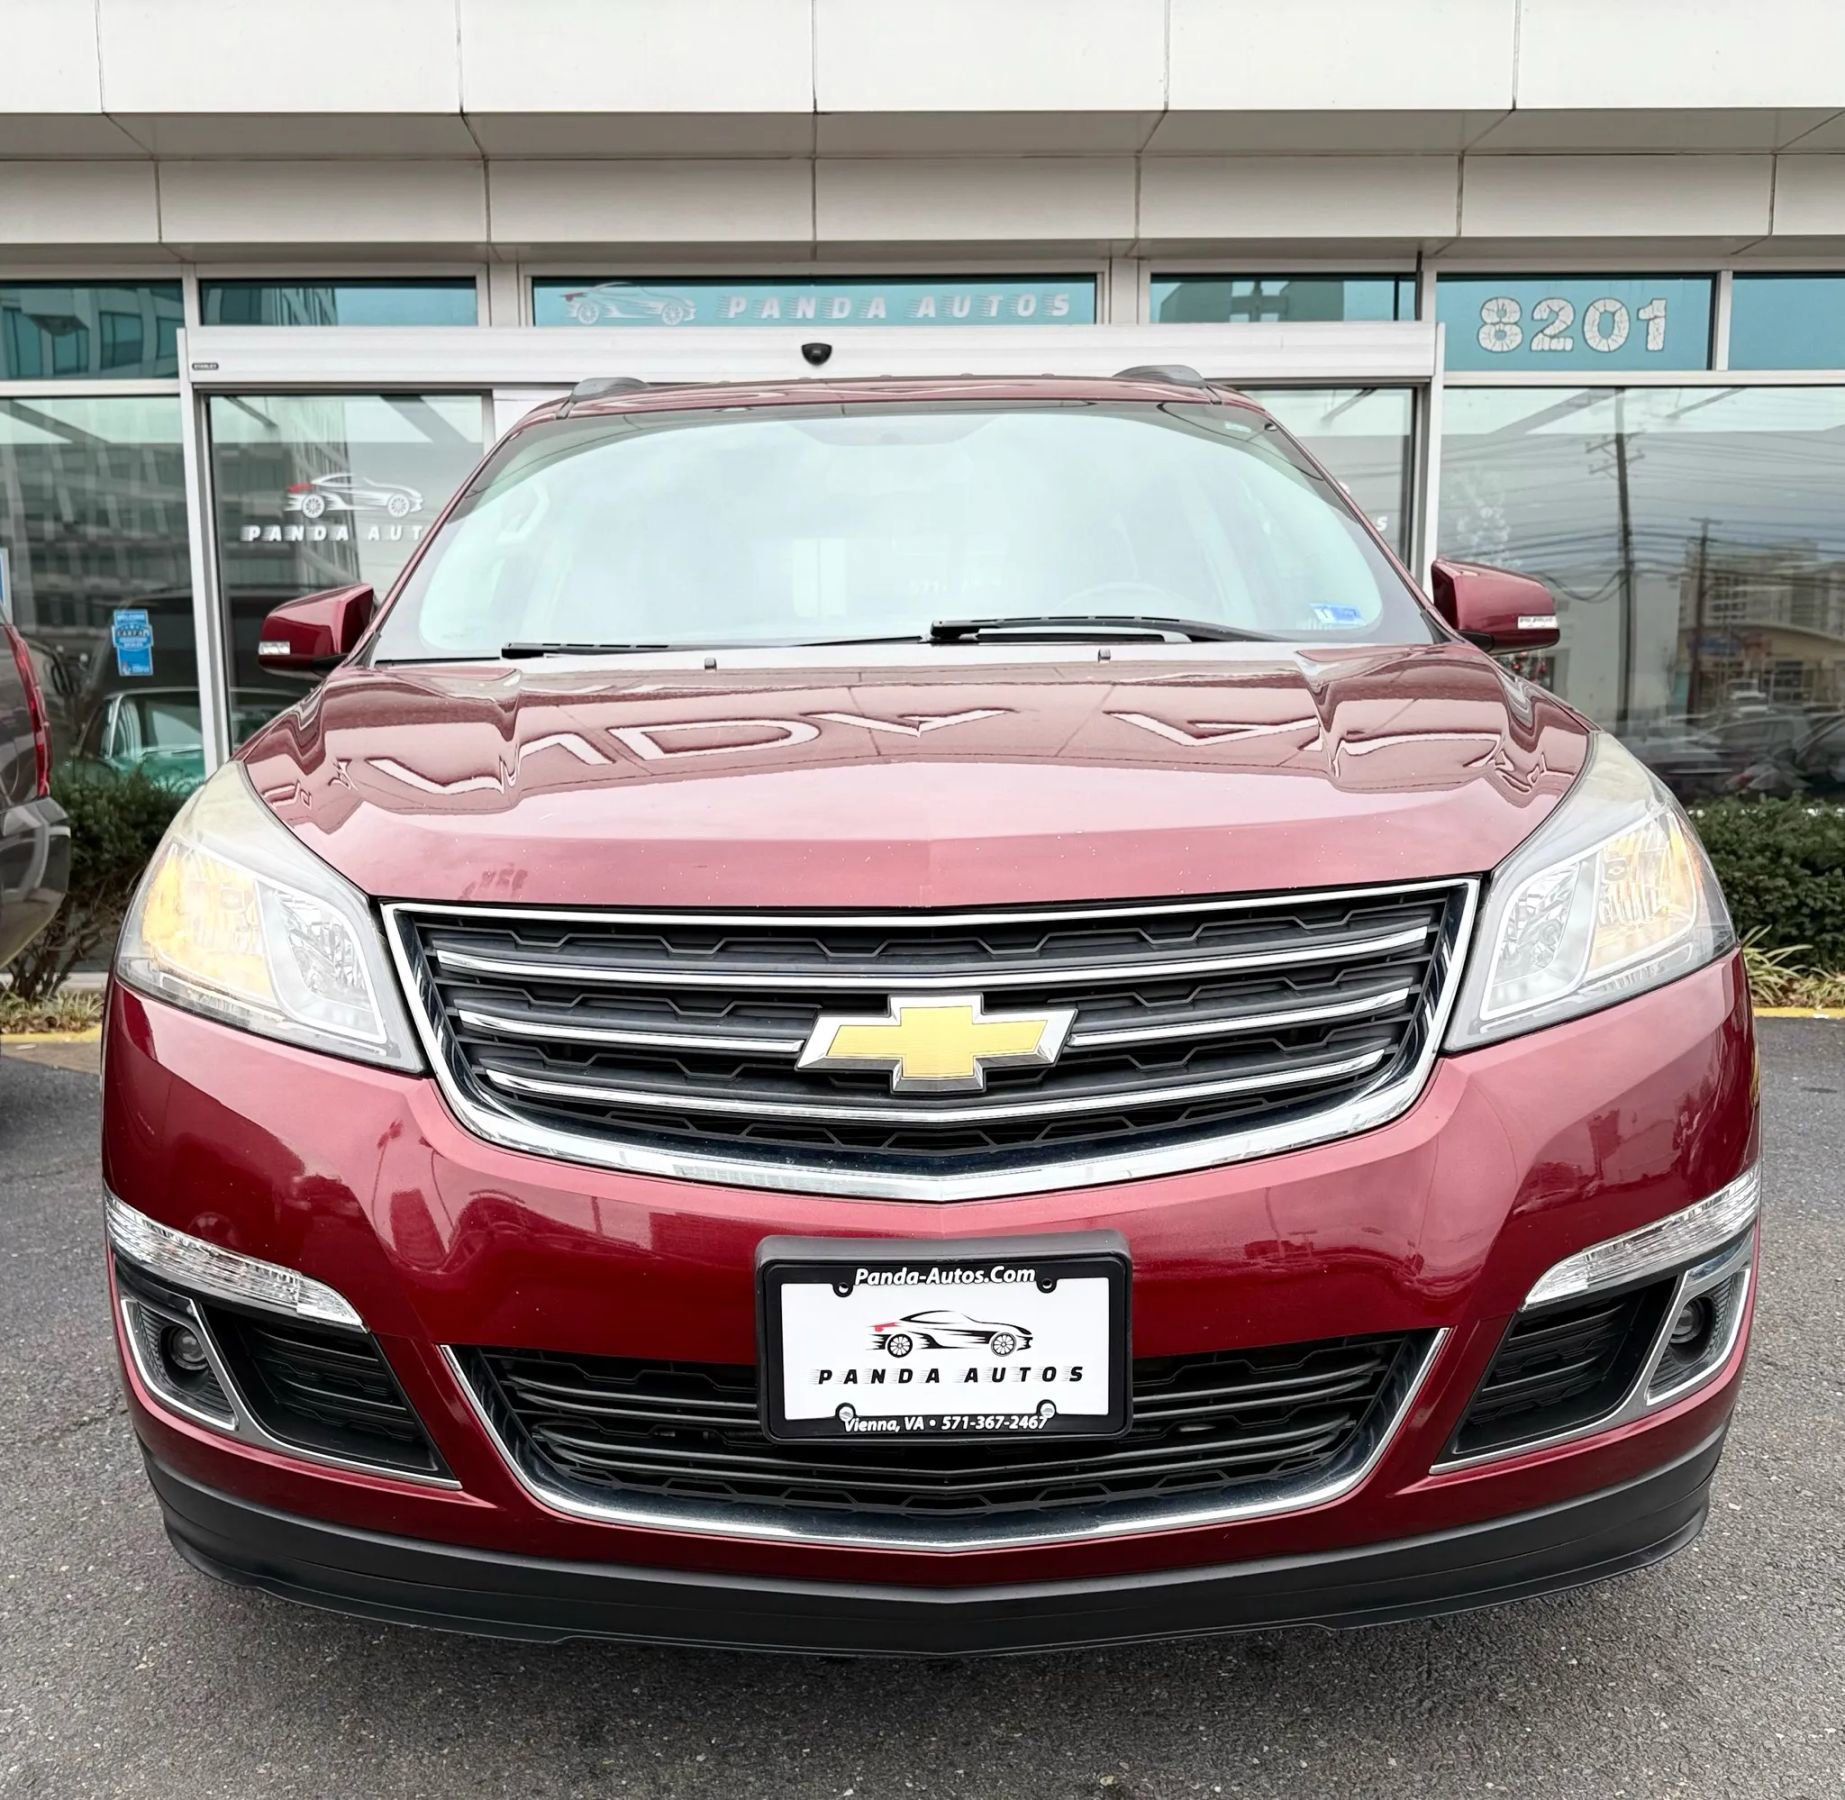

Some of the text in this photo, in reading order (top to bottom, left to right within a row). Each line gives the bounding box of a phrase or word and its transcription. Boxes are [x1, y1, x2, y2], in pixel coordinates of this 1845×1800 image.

[722, 293, 1071, 320] PANDA AUTOS
[1477, 297, 1668, 353] 8201
[241, 525, 423, 542] PANDA AUT
[854, 1265, 1036, 1286] Panda-Autos.Com
[814, 1365, 1084, 1385] PANDA AUTOS
[844, 1415, 1048, 1433] Vienna, VA 571-367-2467
